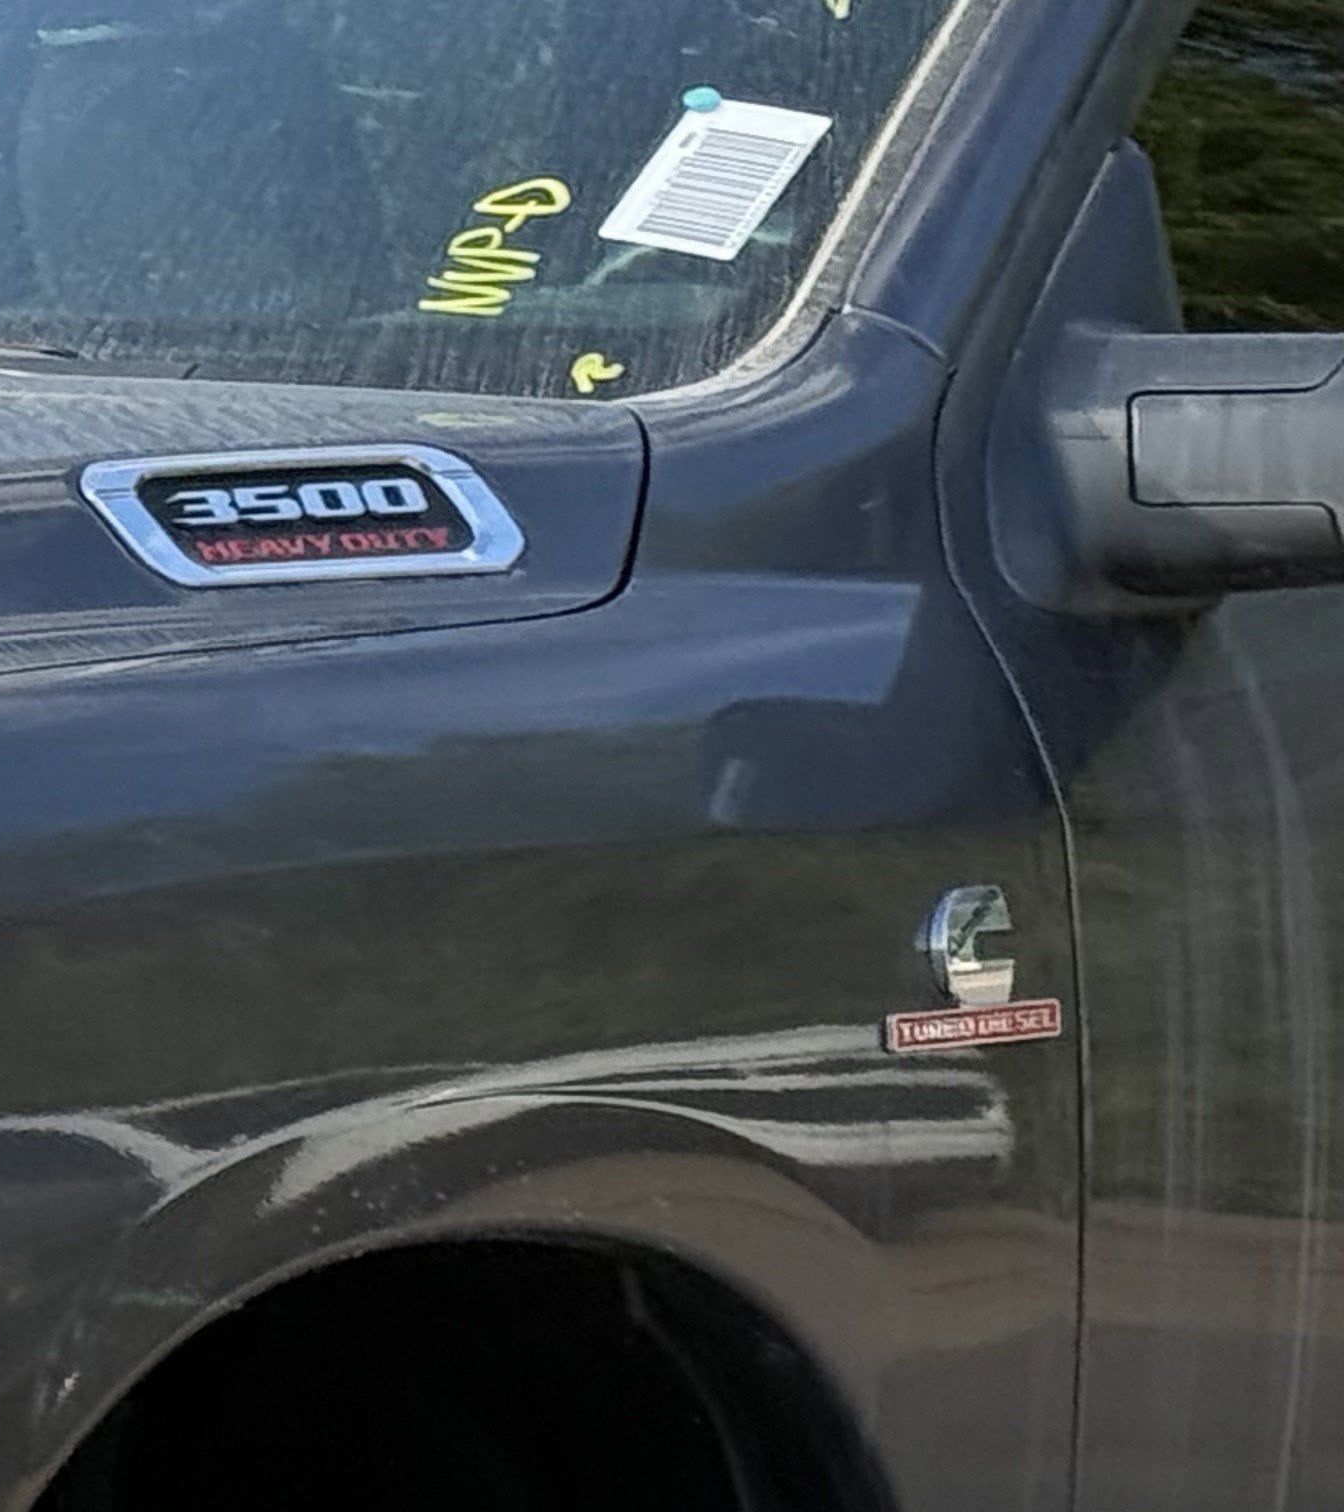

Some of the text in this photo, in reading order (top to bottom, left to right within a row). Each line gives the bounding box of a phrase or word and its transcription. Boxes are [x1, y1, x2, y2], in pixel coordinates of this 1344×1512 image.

[165, 478, 429, 525] 3500
[196, 527, 449, 561] HEAVY DUTY
